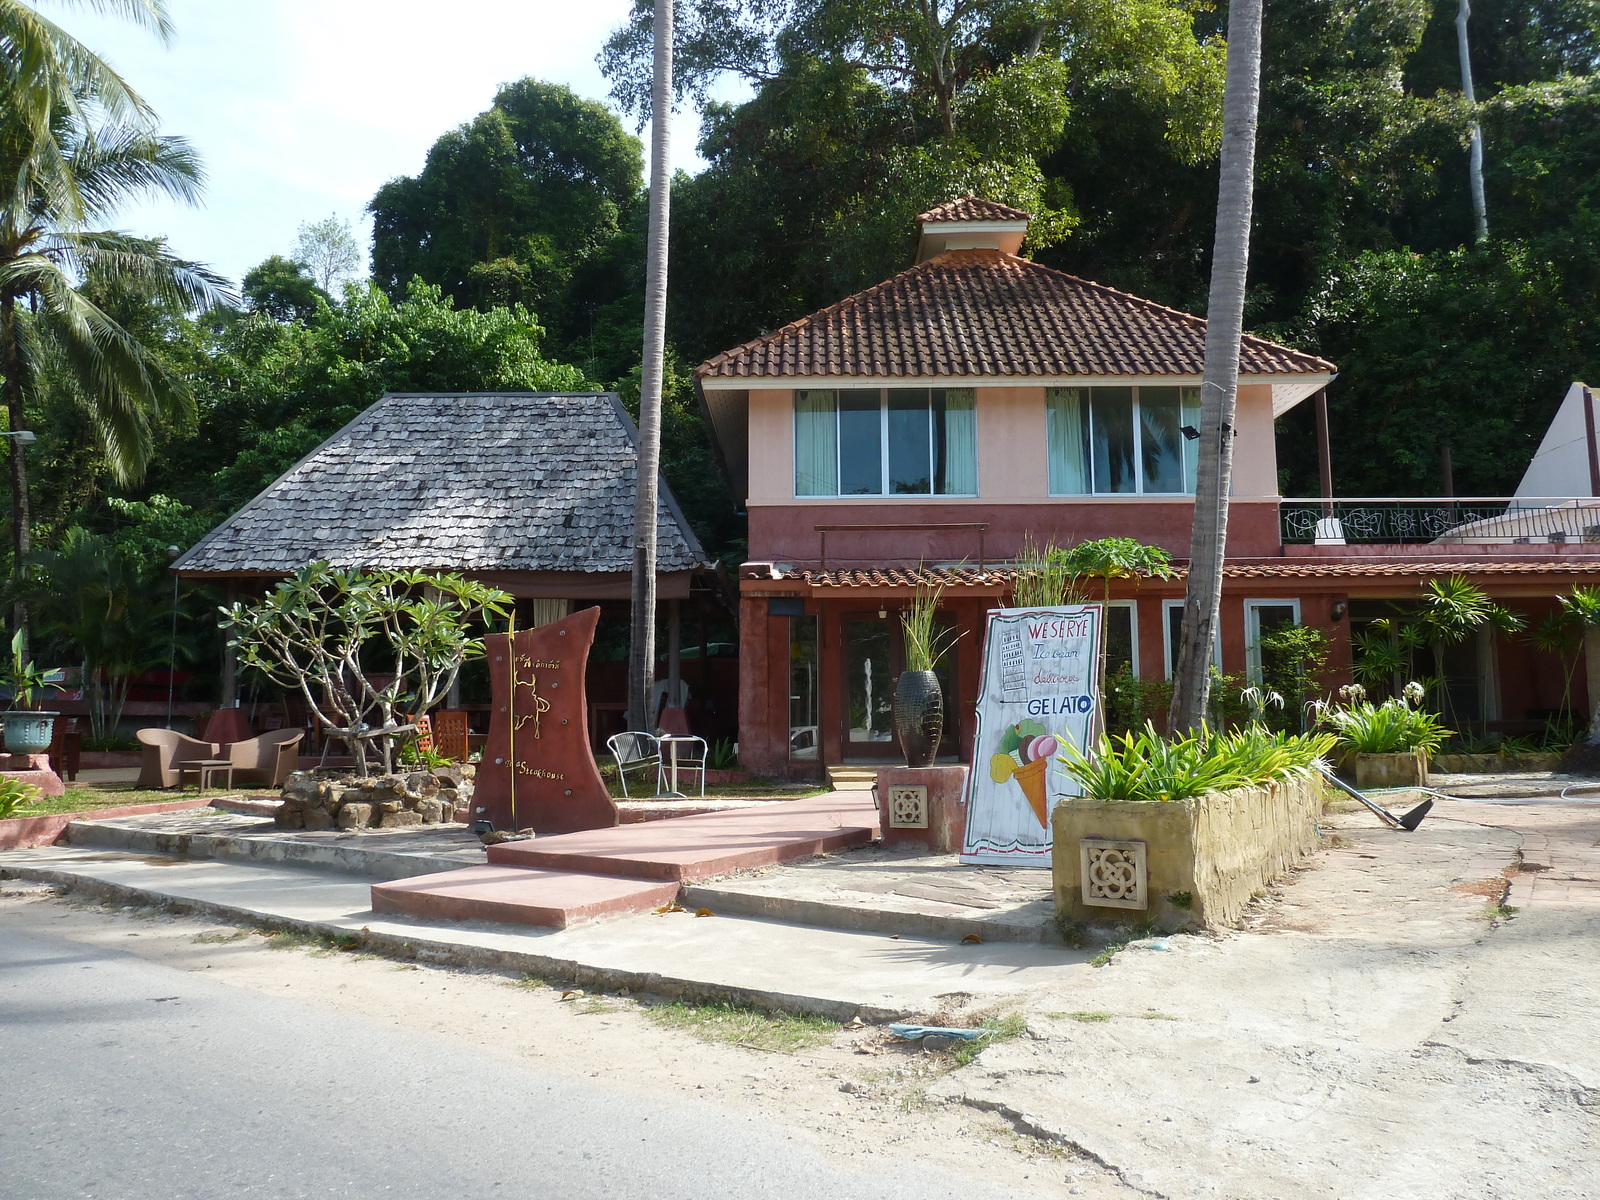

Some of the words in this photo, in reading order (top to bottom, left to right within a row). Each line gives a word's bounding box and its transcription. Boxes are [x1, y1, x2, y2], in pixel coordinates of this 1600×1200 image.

[1028, 622, 1048, 639] WE
[1028, 695, 1091, 715] GELATO
[519, 761, 564, 780] Steakhouse
